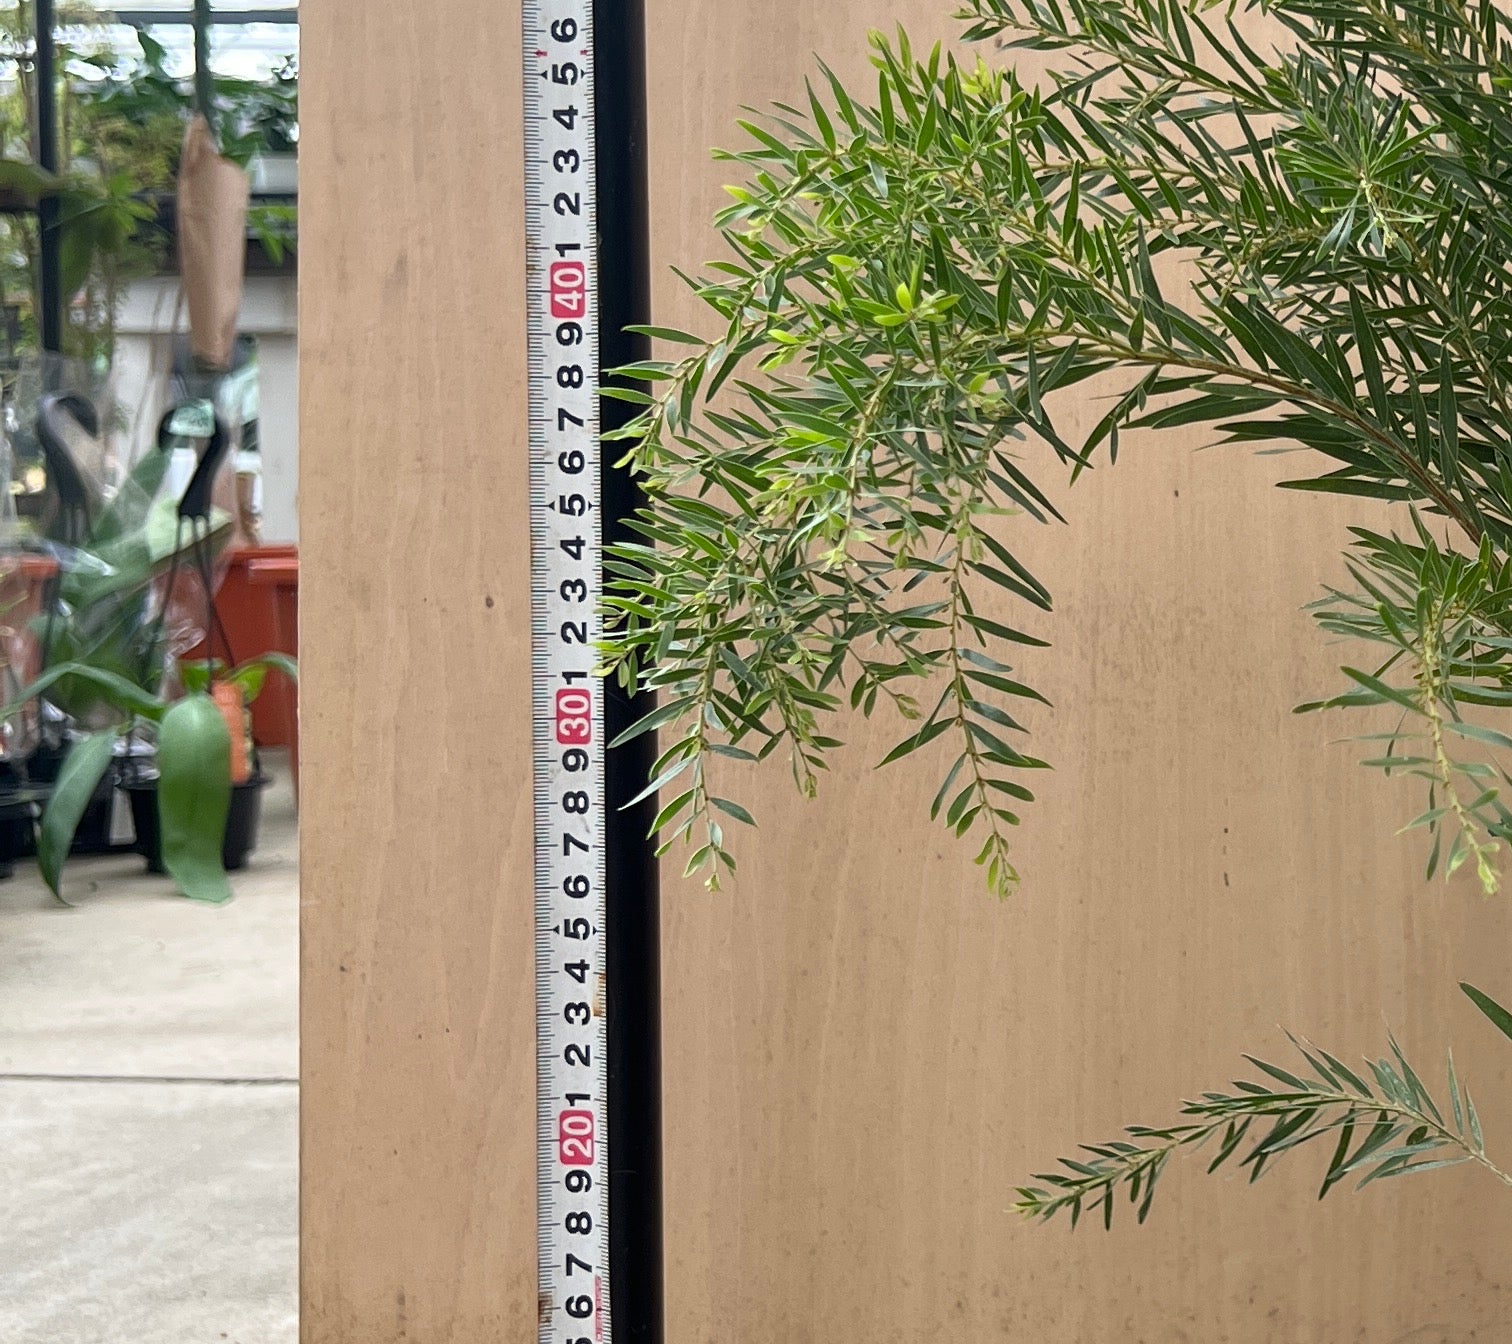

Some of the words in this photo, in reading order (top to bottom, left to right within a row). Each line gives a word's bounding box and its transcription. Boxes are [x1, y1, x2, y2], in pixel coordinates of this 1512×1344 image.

[550, 17, 578, 43] 6
[551, 62, 578, 86] 5
[552, 104, 579, 131] 4
[552, 148, 580, 174] 3
[553, 192, 580, 216] 2
[555, 243, 581, 258] 1
[553, 268, 583, 310] 40
[555, 321, 583, 347] 9
[556, 364, 584, 389] 8
[557, 407, 584, 432] 7
[557, 450, 585, 475] 6
[559, 493, 586, 517] 5
[559, 535, 586, 561] 4
[559, 578, 587, 603] 3
[560, 621, 587, 644] 2
[561, 671, 588, 685] 1
[559, 695, 589, 736] 30
[561, 748, 589, 773] 9
[562, 790, 590, 815] 8
[563, 832, 589, 857] 7
[563, 874, 590, 899] 6
[563, 917, 590, 941] 5
[564, 959, 590, 984] 4
[563, 1001, 591, 1026] 3
[564, 1043, 591, 1067] 2
[565, 1093, 591, 1107] 1
[562, 1116, 592, 1158] 20
[564, 1169, 592, 1193] 9
[564, 1211, 593, 1236] 8
[565, 1253, 593, 1277] 7
[565, 1294, 593, 1319] 6
